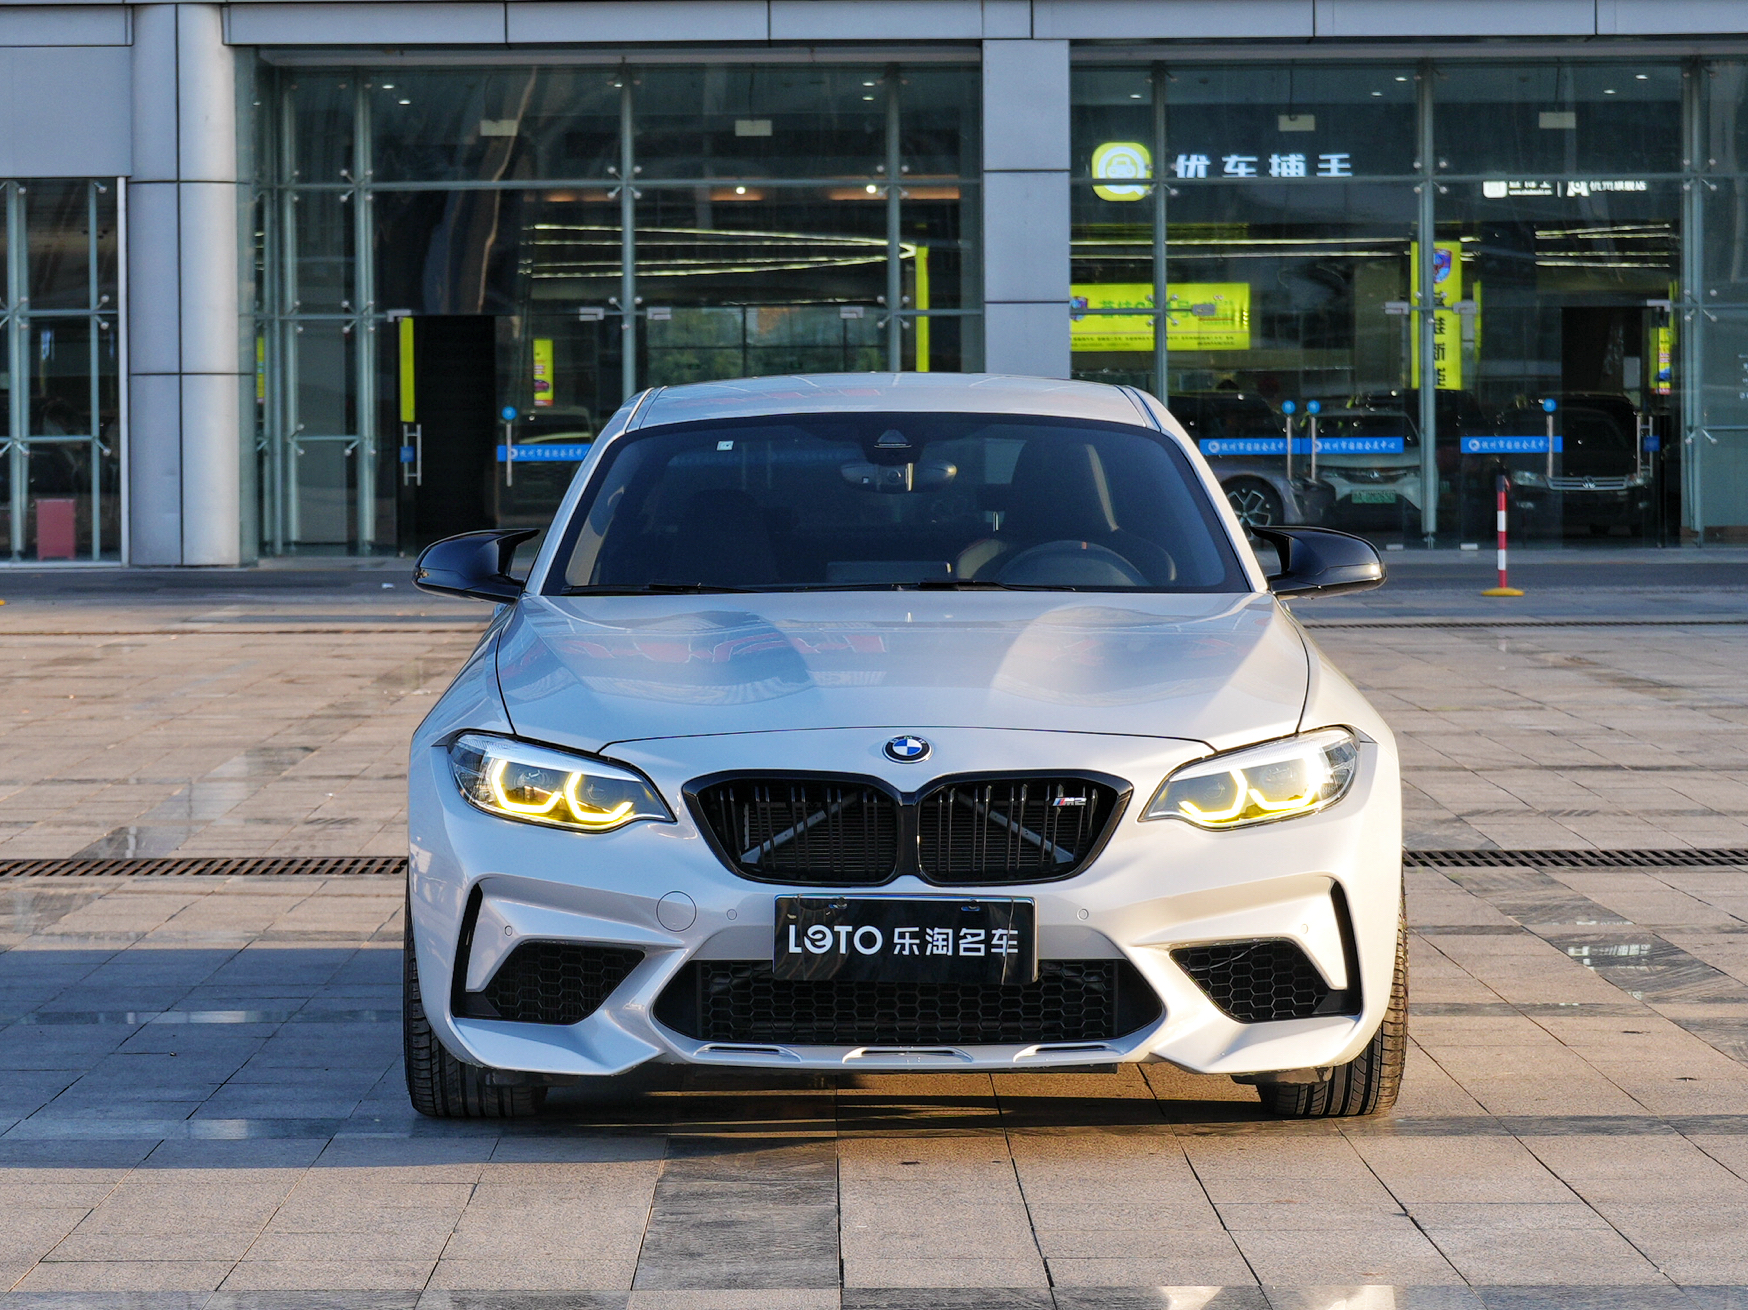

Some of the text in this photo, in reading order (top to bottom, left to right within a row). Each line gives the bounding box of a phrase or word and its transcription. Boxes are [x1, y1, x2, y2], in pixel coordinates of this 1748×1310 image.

[1059, 797, 1087, 806] M2
[788, 924, 1019, 957] LOTO 乐淘名车
